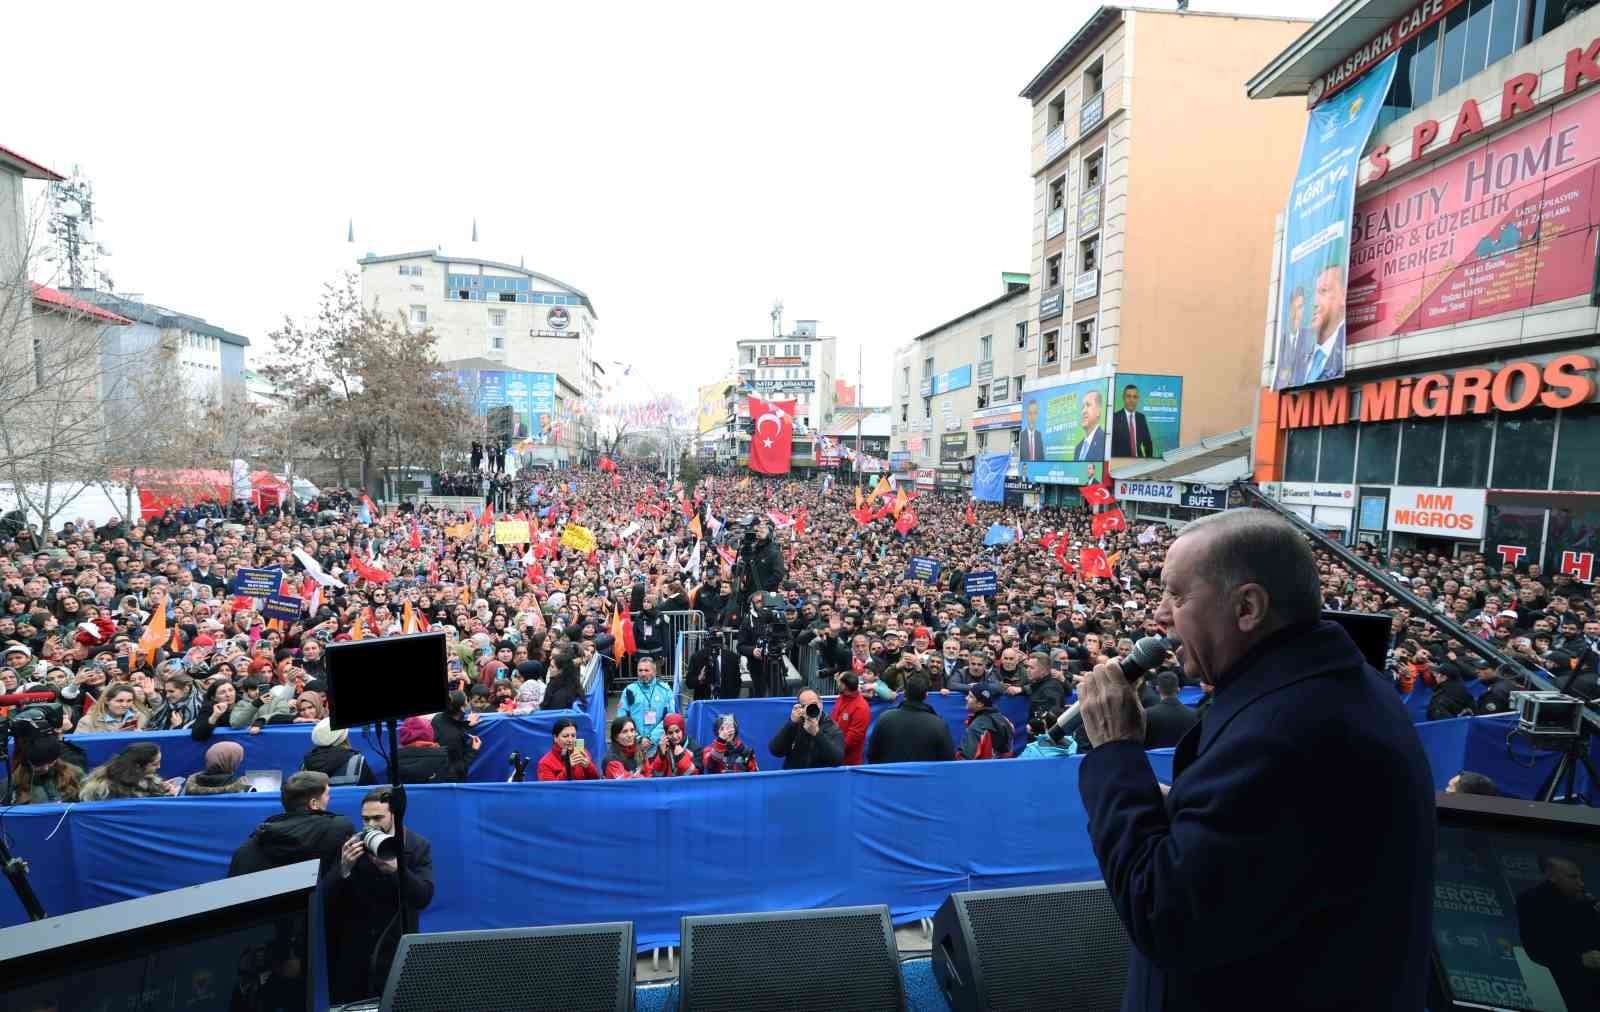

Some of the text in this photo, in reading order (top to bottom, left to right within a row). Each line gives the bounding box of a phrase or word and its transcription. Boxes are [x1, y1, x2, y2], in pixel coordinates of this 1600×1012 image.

[1326, 0, 1442, 92] HASPARK CAFE
[1464, 124, 1580, 202] HOME
[1384, 233, 1457, 277] MERKEZİ
[1409, 227, 1421, 246] &
[1280, 386, 1350, 429] MM
[1416, 494, 1453, 511] MM
[1561, 551, 1594, 582] H
